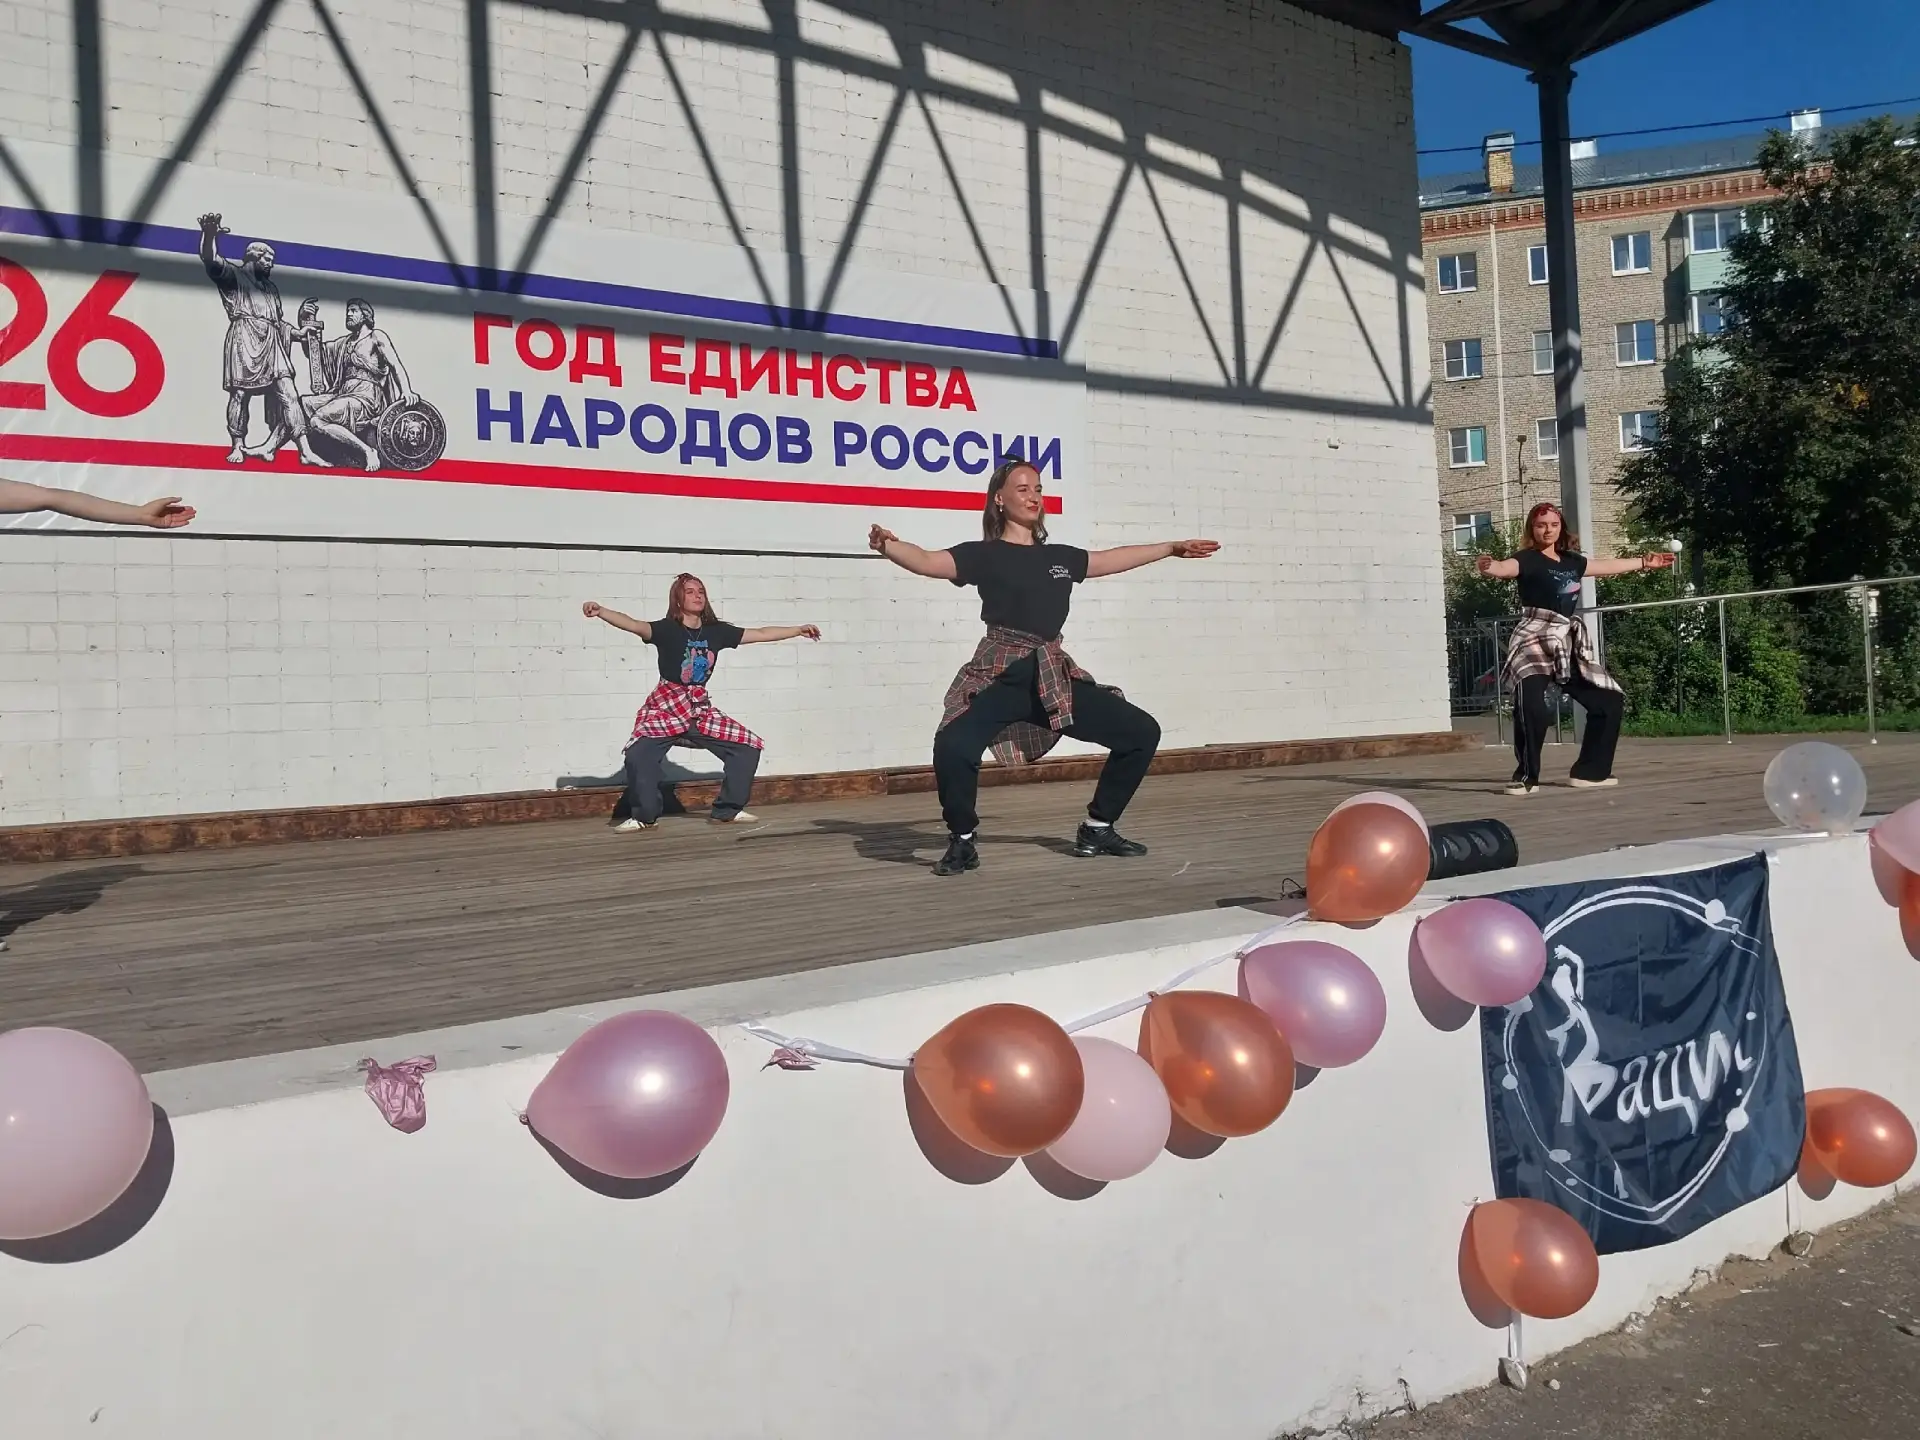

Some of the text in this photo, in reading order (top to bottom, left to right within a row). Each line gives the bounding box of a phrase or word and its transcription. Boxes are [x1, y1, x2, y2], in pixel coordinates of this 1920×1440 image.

[473, 311, 977, 412] ГОД ЕДИНСТВА
[476, 388, 1062, 479] НАРОДОВ РОССИИ
